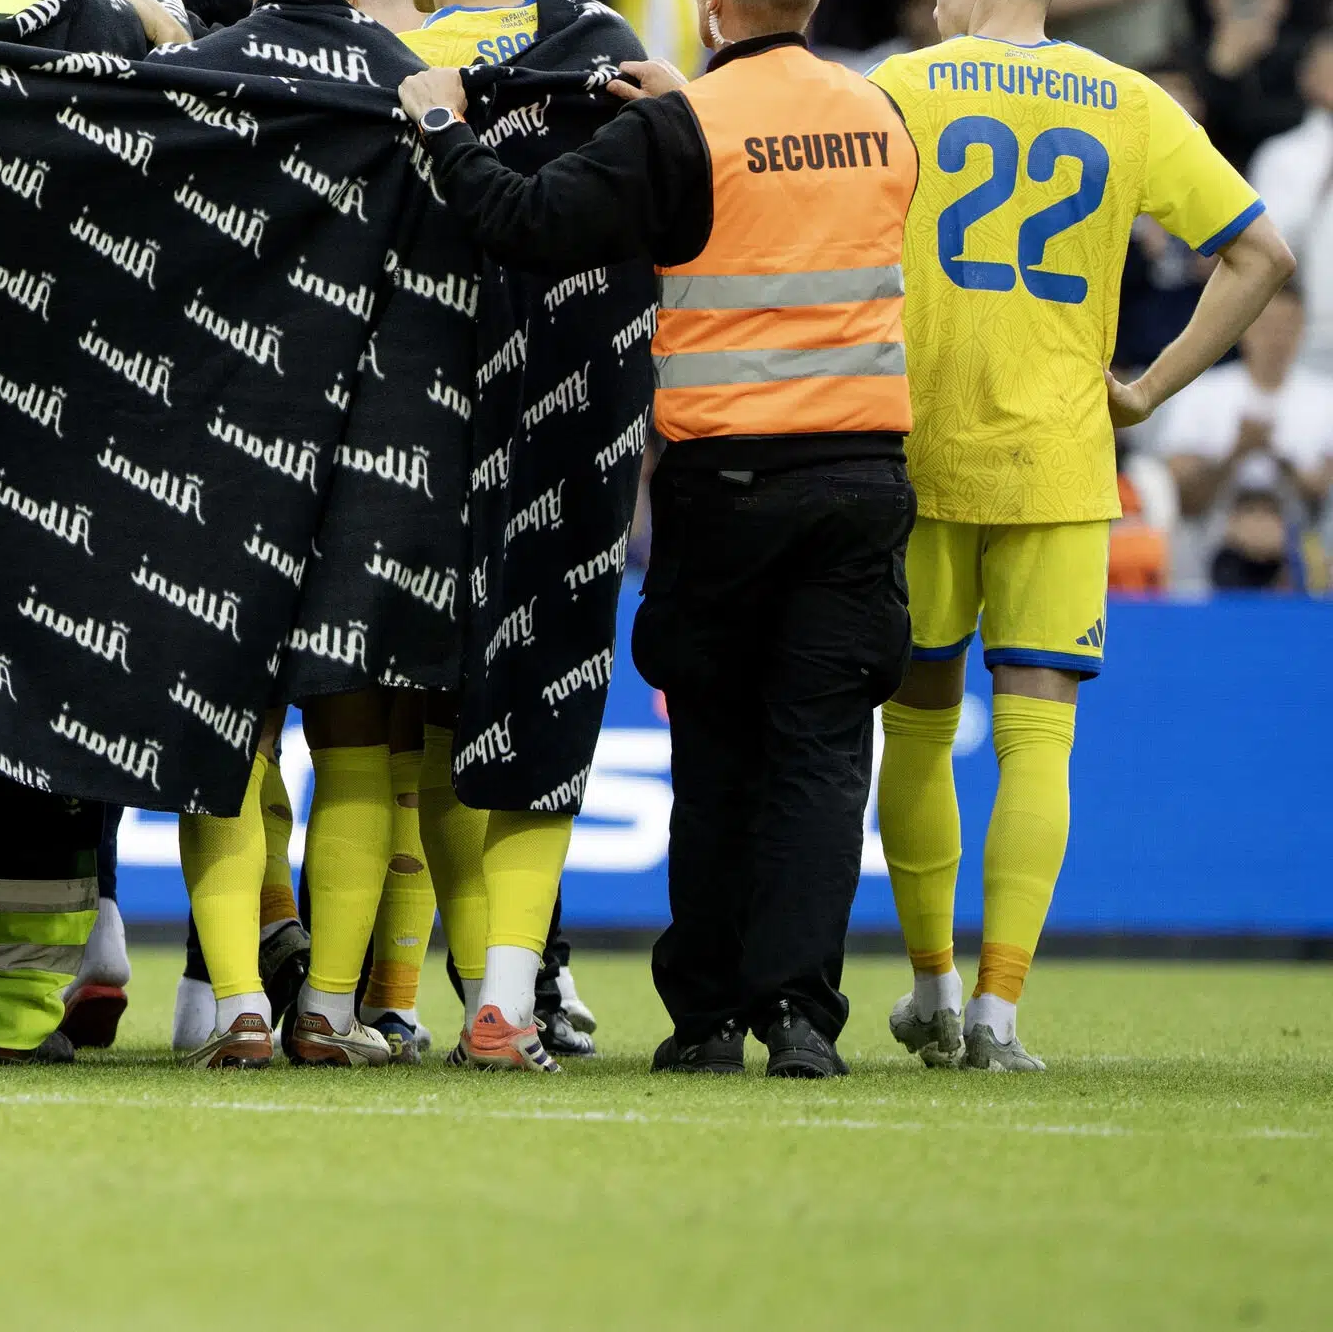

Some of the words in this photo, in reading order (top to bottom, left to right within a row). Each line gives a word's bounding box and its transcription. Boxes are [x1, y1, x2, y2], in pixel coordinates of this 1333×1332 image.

[928, 62, 1119, 111] MATVIYENKO
[744, 131, 890, 174] SECURITY
[937, 115, 1110, 305] 22
